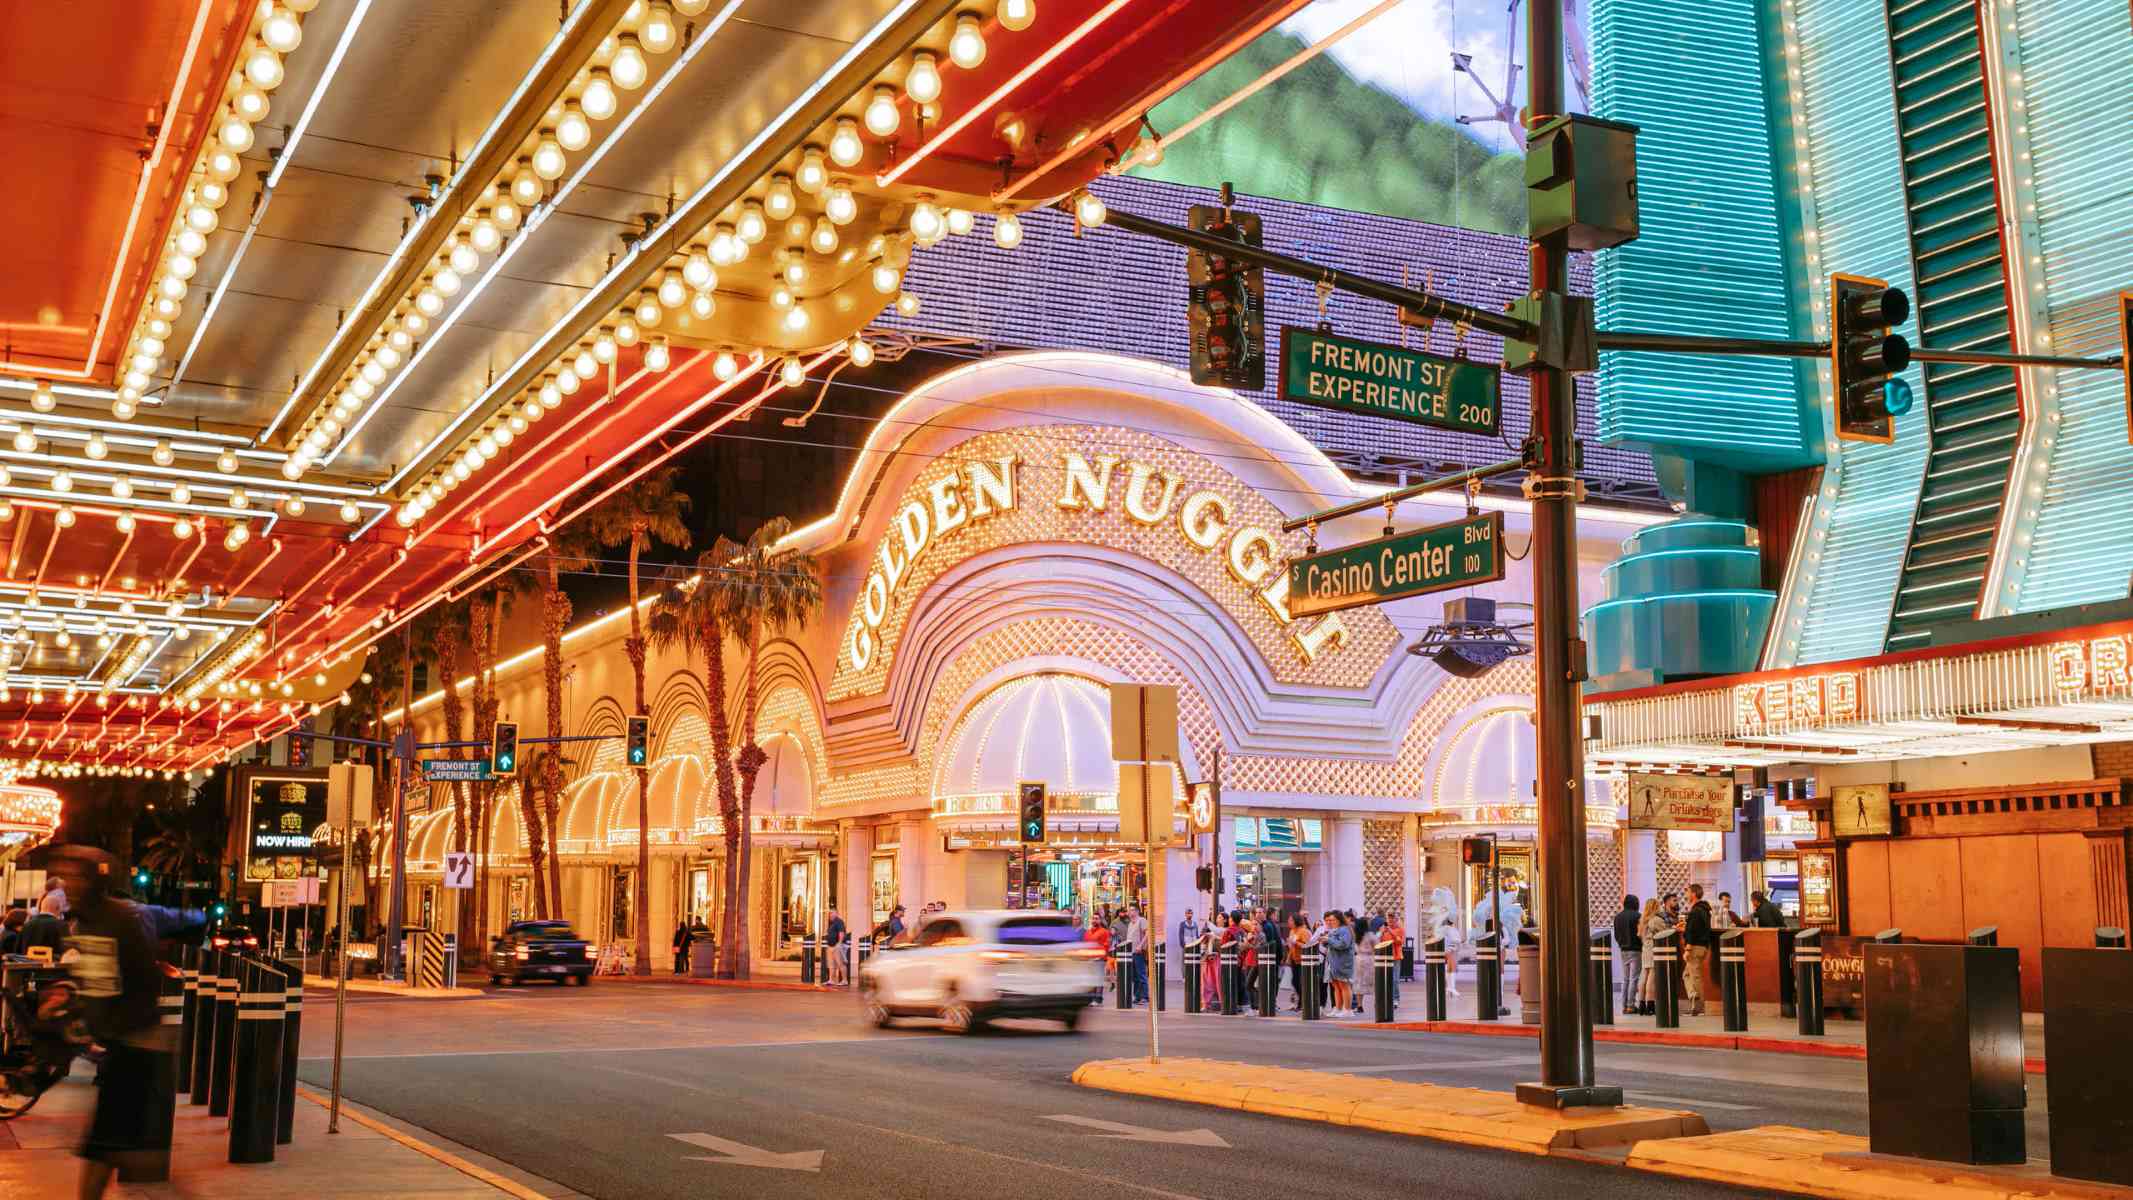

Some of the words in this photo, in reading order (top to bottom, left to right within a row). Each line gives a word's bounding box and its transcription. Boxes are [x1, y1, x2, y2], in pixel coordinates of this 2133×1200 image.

[1311, 342, 1414, 381] FREMONT
[1420, 363, 1446, 388] ST
[1308, 371, 1445, 418] EXPERIENCE
[1459, 403, 1491, 426] 200
[850, 453, 1020, 672] GOLDEN
[1293, 565, 1300, 581] S
[1307, 557, 1373, 600] Casino
[1379, 542, 1454, 586] Center
[1463, 521, 1491, 546] Blvd
[1464, 555, 1481, 574] 100
[2050, 636, 2133, 690] CR
[1736, 672, 1857, 726] KENO
[431, 761, 469, 771] FREMONT
[256, 835, 286, 848] NOW
[1822, 958, 1864, 973] COWGI
